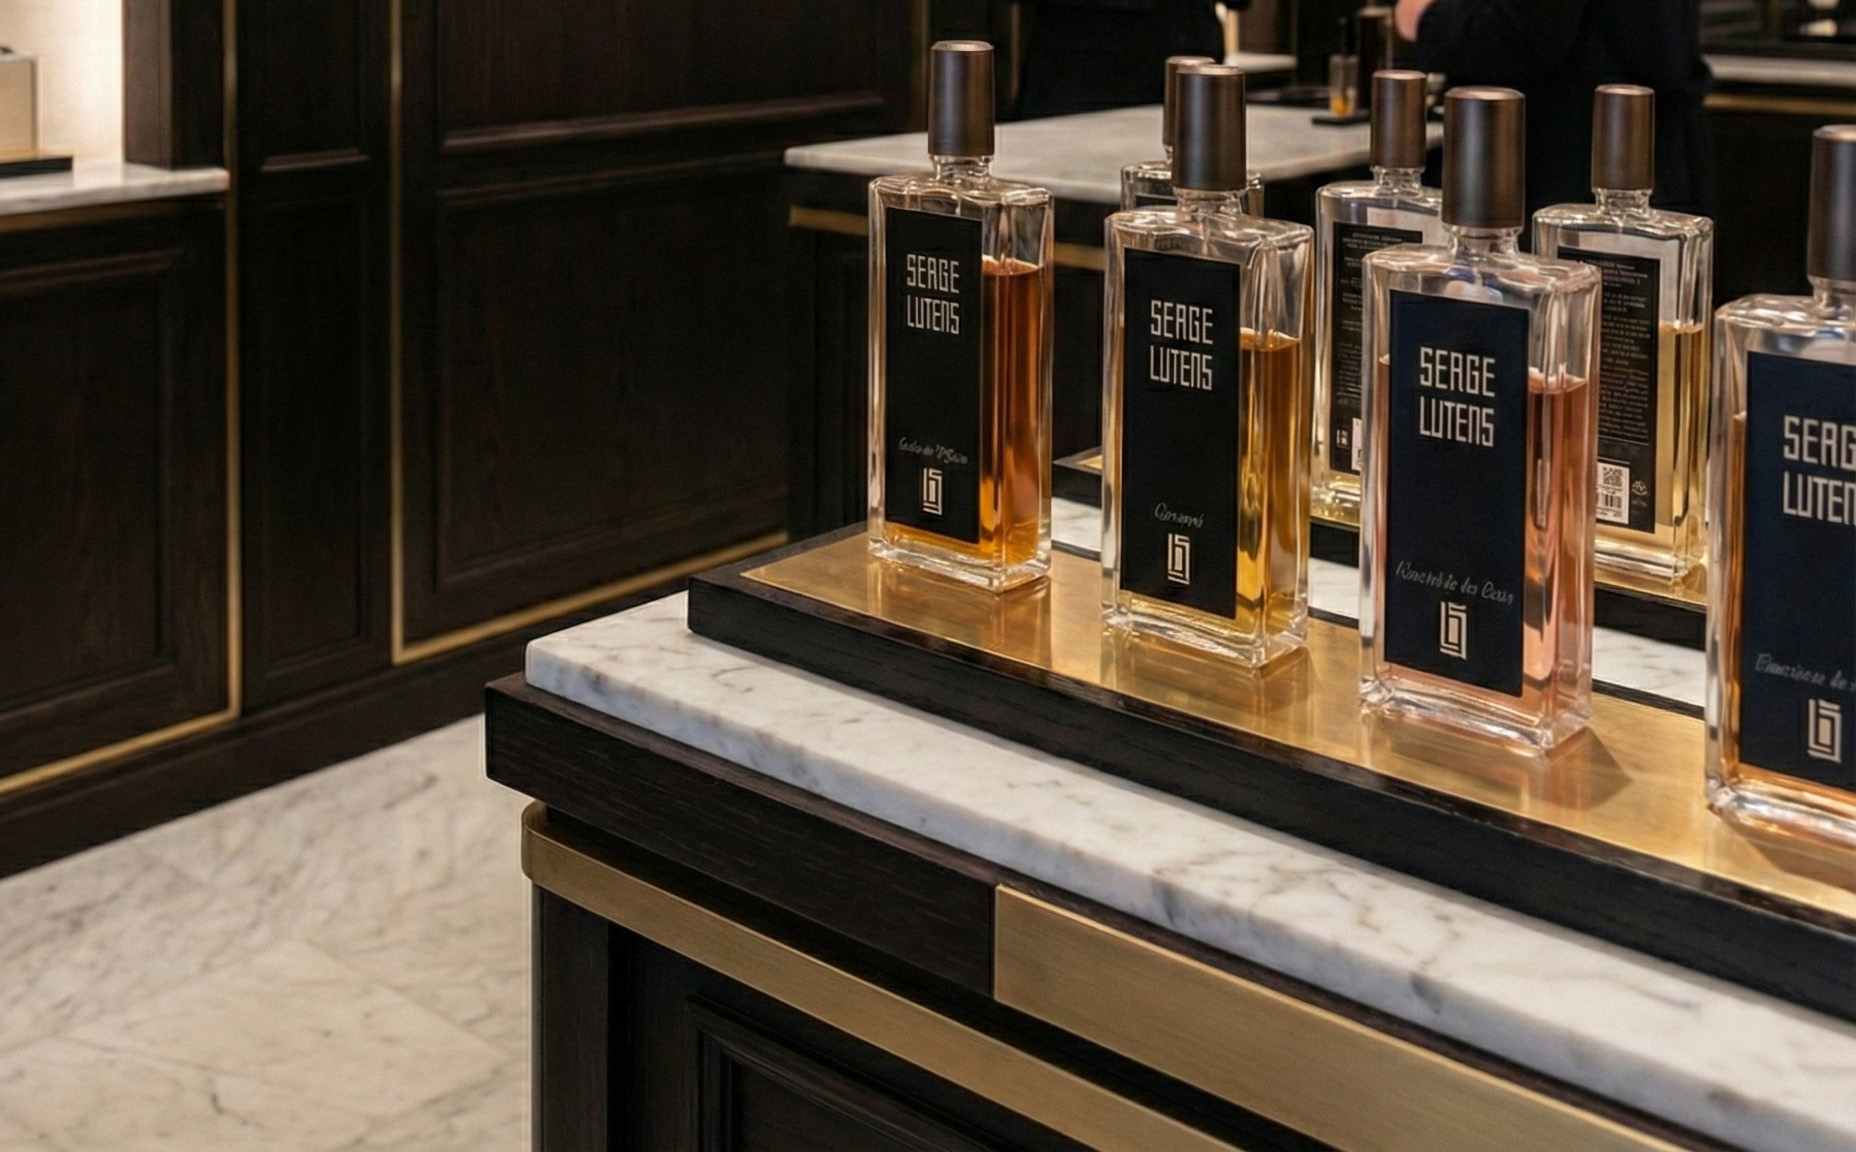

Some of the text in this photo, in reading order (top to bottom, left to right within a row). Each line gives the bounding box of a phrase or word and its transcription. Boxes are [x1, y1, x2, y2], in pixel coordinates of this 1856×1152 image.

[906, 253, 960, 294] SERGE
[906, 294, 960, 335] LUTENS
[1150, 299, 1214, 345] SERGE
[1149, 344, 1213, 391] LUTENS
[1419, 346, 1496, 398] SERGE
[1419, 395, 1495, 448] LUTENS
